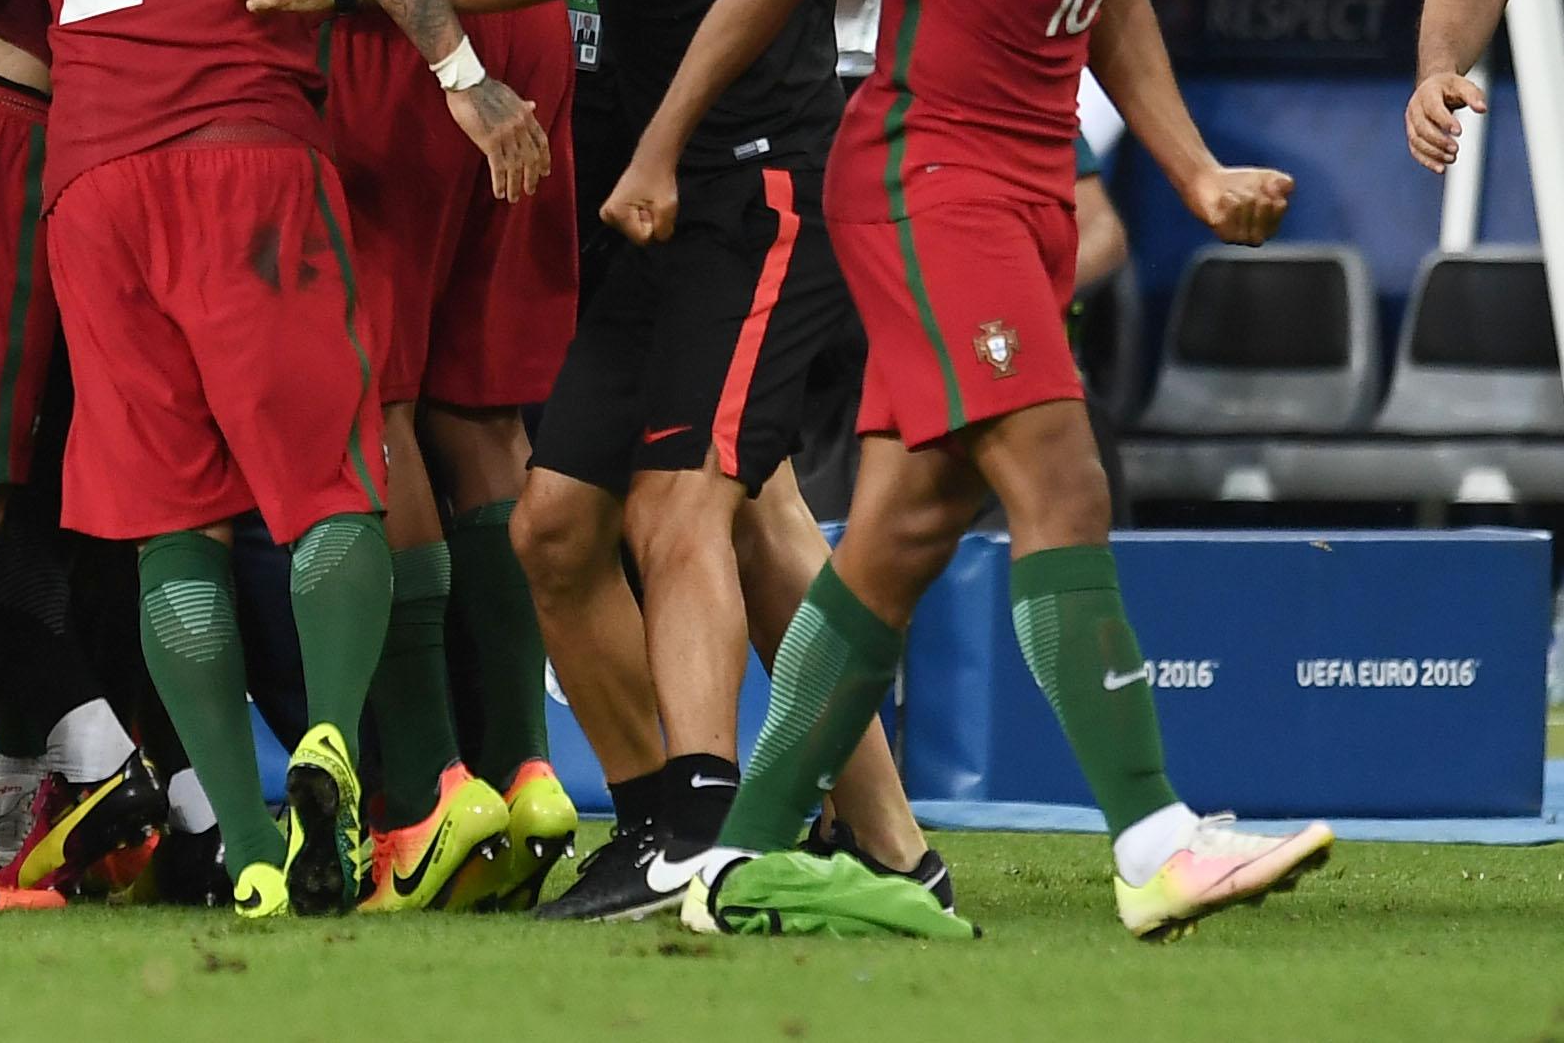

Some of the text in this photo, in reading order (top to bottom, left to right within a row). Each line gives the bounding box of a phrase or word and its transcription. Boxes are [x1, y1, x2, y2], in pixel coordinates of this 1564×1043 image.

[1157, 659, 1214, 689] 2016
[1297, 660, 1476, 687] UEFA EURO 2016
